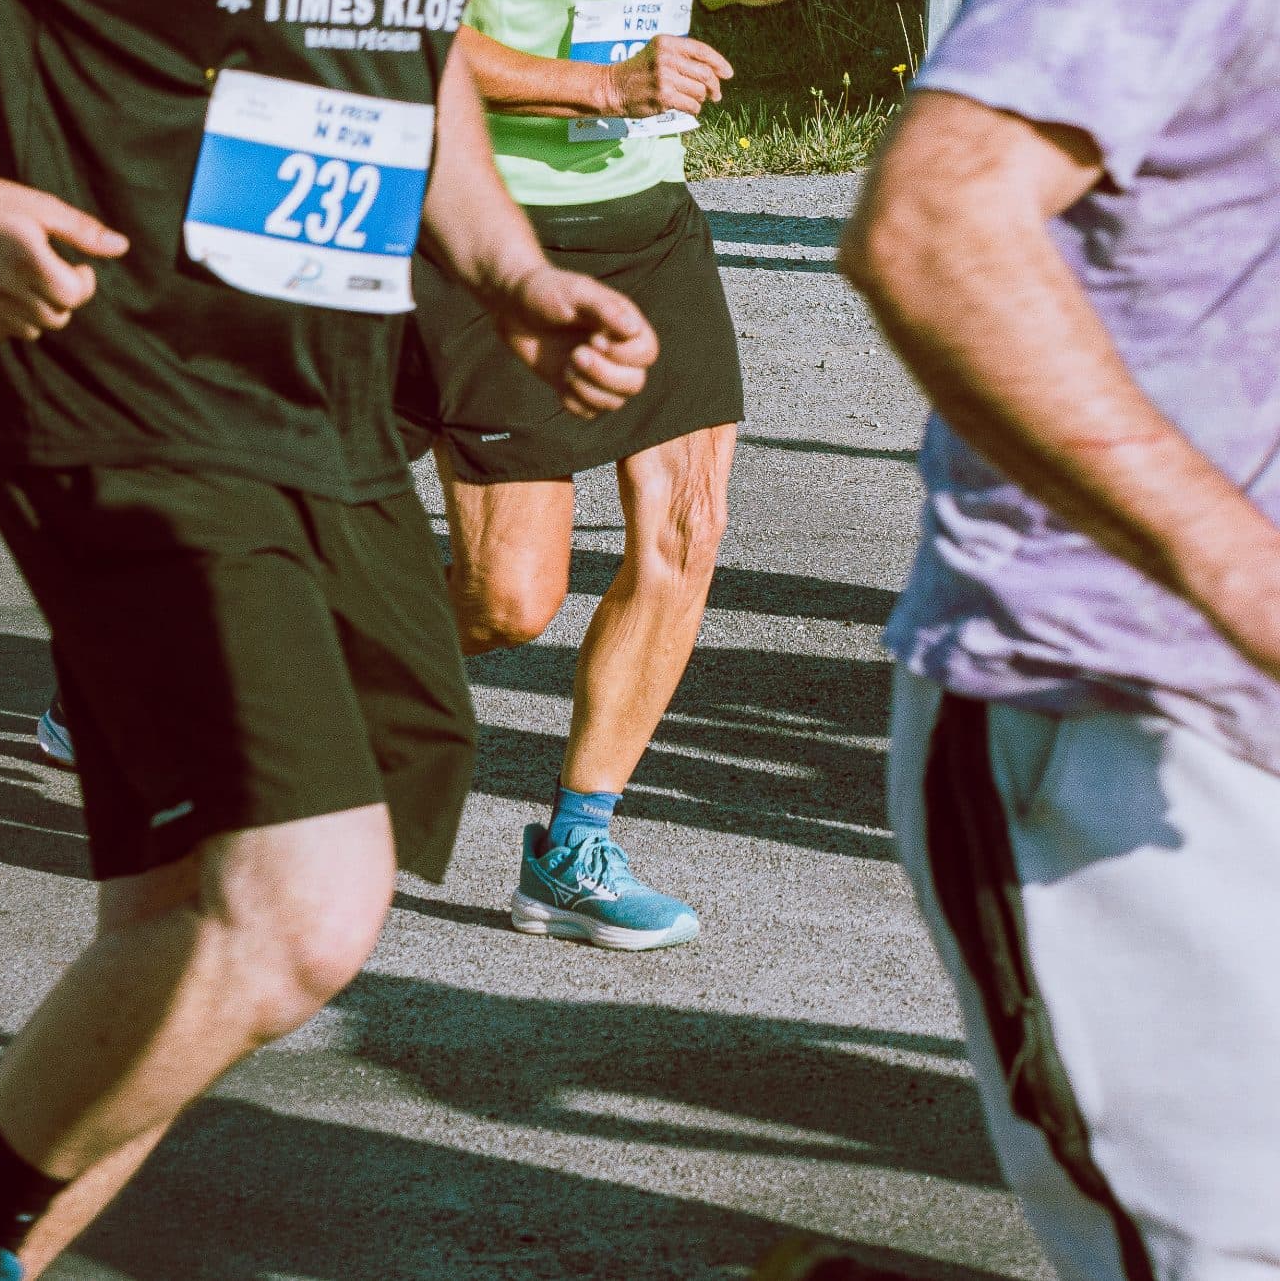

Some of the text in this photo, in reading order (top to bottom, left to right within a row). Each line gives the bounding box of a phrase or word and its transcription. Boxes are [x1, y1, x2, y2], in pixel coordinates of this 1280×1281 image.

[623, 5, 634, 14] LA
[624, 18, 658, 31] N RUN
[338, 126, 374, 148] RUN
[264, 152, 382, 249] 232
